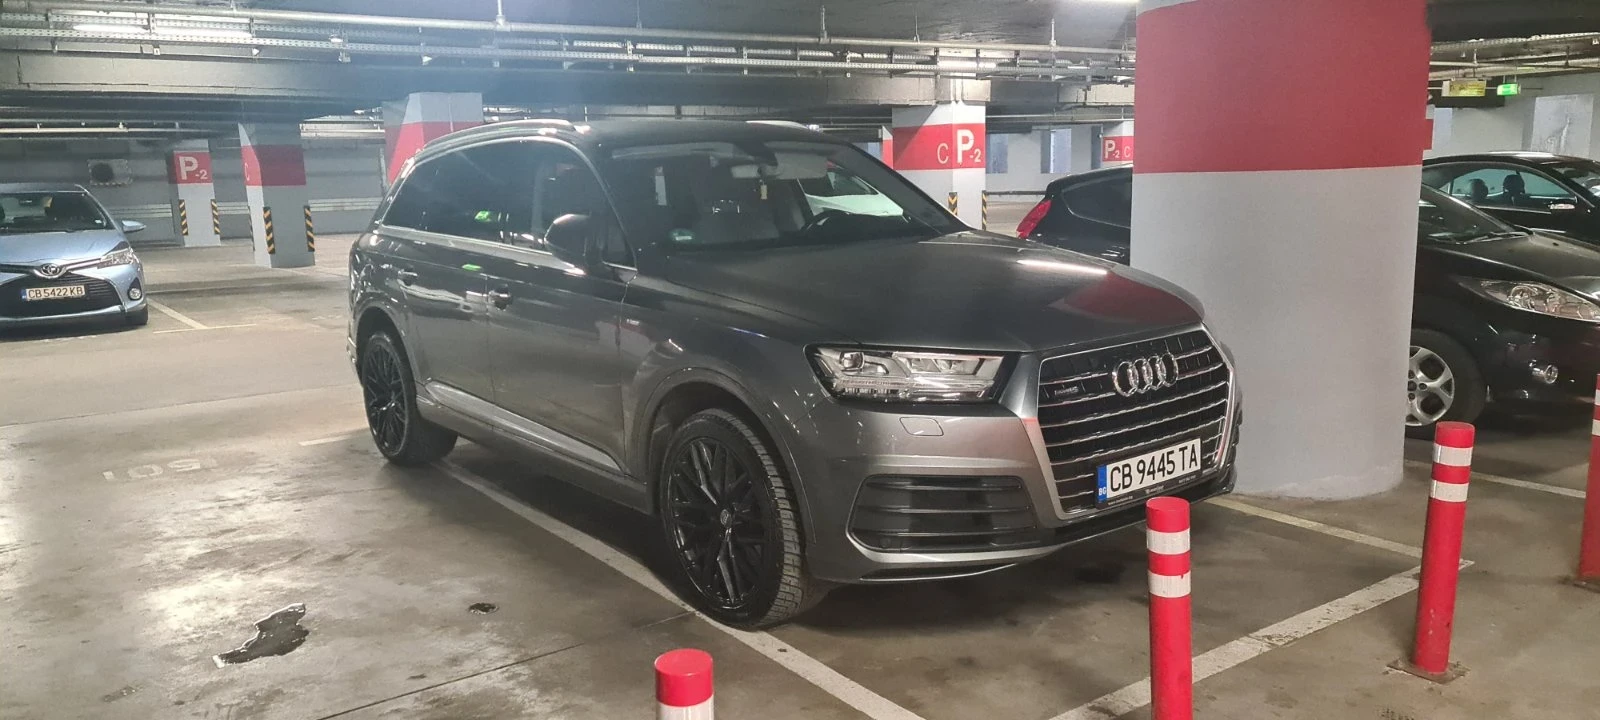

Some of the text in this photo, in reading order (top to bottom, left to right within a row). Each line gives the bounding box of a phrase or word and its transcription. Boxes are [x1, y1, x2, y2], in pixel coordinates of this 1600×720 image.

[937, 143, 949, 164] C
[1124, 146, 1131, 158] C
[43, 287, 68, 298] 5422
[1110, 444, 1198, 492] CB 9445 TA
[1098, 486, 1107, 496] BG
